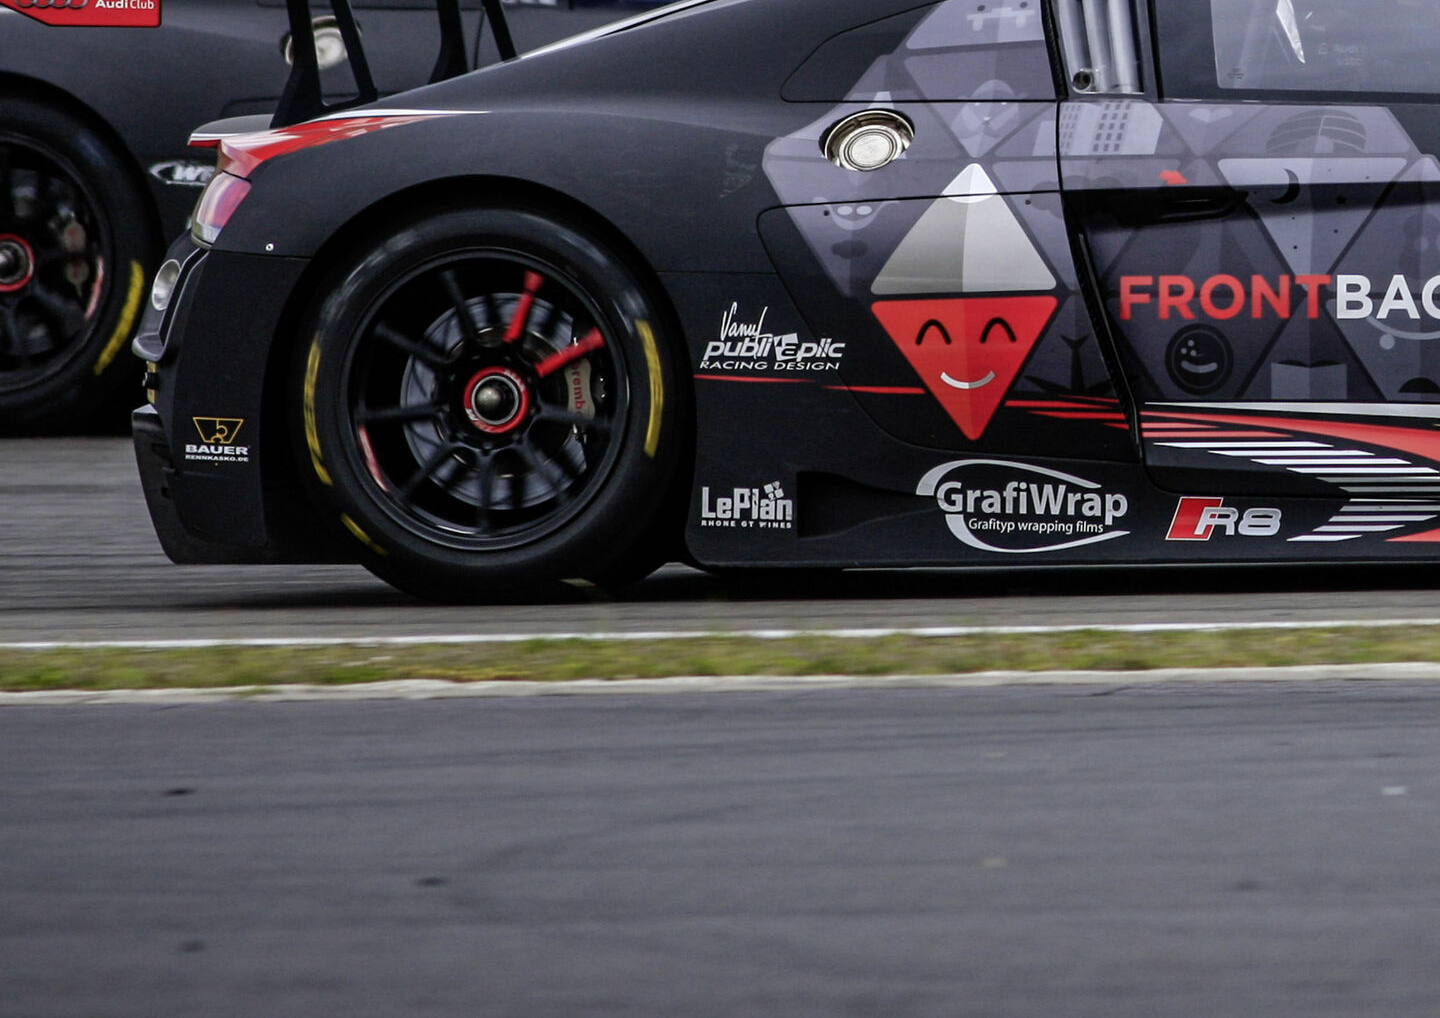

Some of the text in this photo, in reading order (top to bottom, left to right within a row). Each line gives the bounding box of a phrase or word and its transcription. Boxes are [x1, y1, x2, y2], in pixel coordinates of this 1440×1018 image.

[699, 361, 840, 371] RACING DESIGN
[185, 444, 249, 455] BAUER
[936, 481, 1128, 526] GrafiWrap
[968, 517, 1104, 535] Grafityp wrapping films
